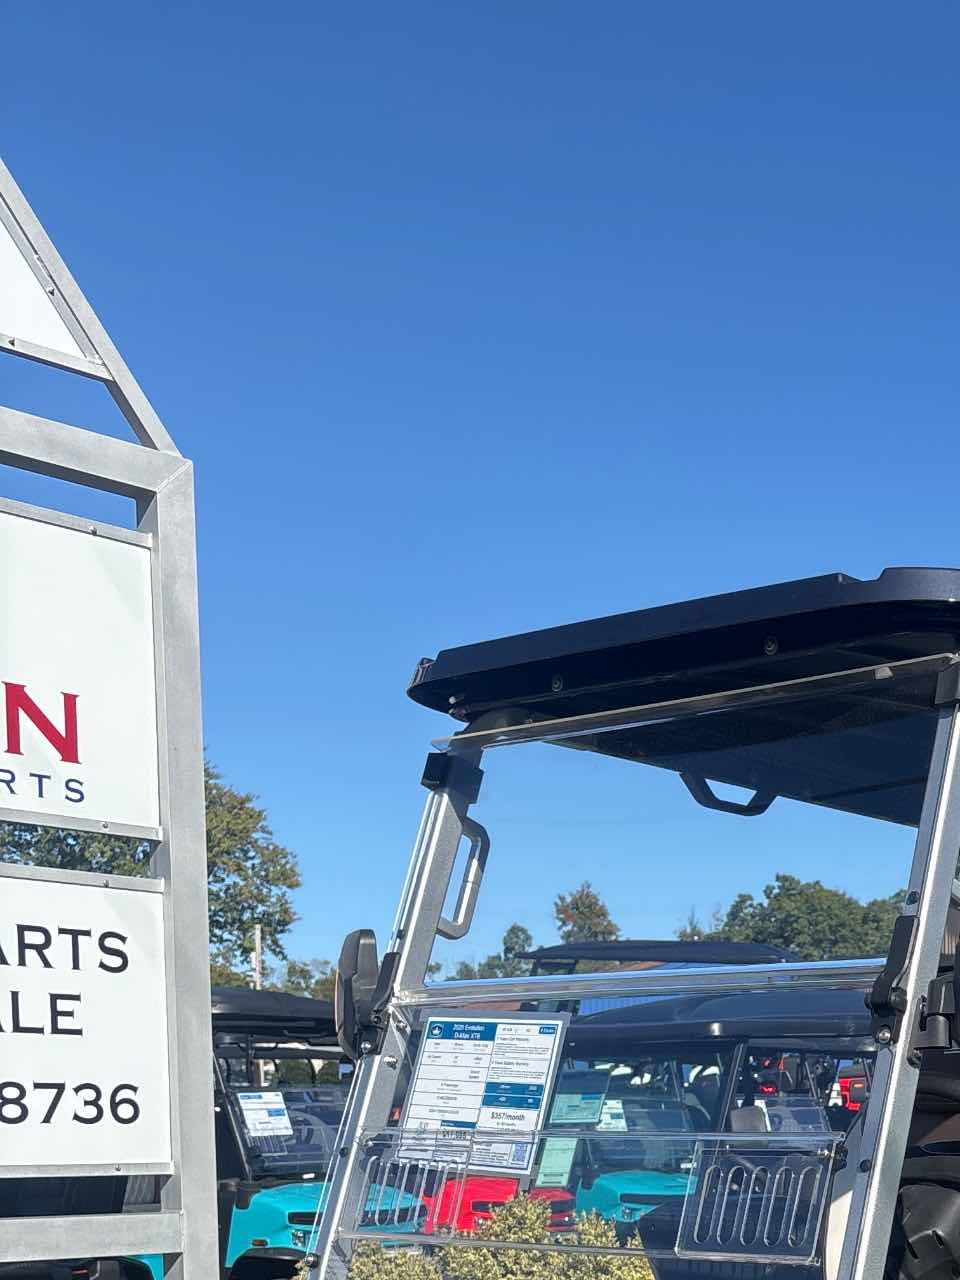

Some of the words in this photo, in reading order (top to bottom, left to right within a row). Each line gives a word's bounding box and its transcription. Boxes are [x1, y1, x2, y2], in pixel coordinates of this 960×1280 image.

[1, 681, 82, 764] N
[0, 923, 129, 974] RTS
[0, 990, 83, 1036] LE
